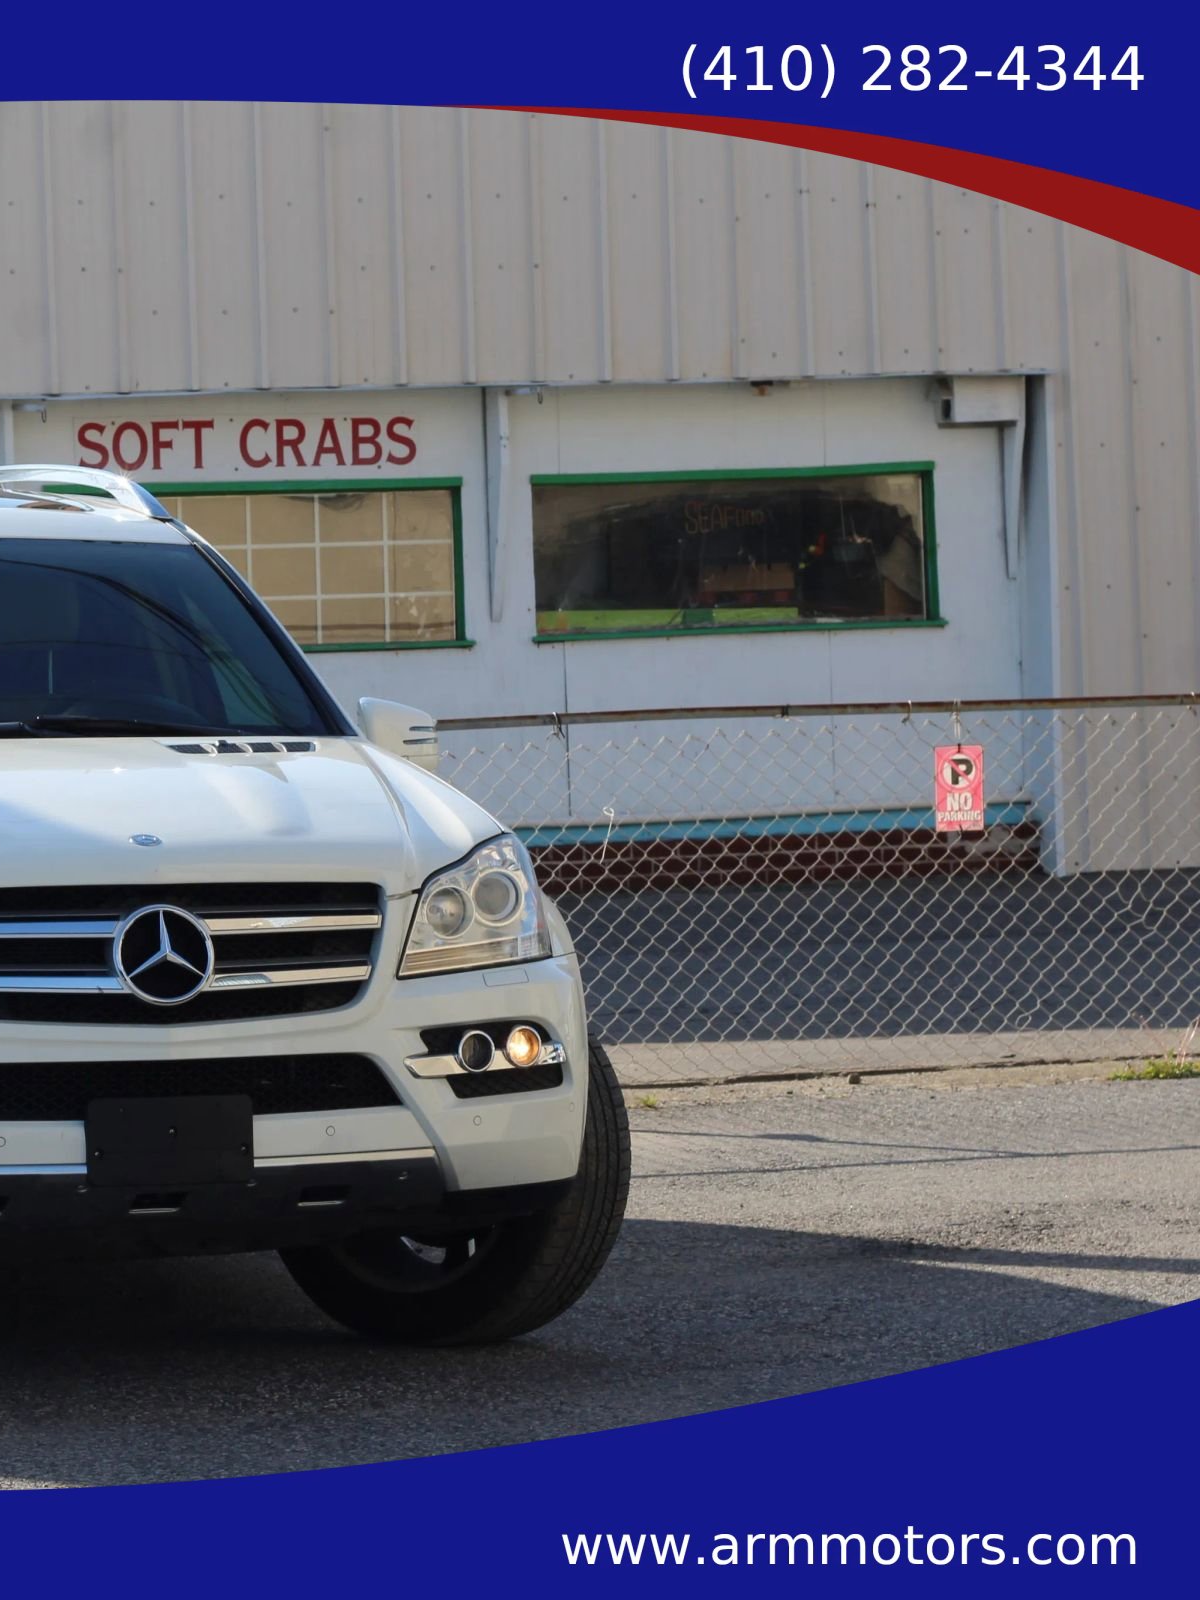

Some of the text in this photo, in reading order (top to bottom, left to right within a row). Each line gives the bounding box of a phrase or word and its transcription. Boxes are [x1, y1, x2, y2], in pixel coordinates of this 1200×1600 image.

[77, 416, 418, 471] SOFT CRABS
[946, 791, 973, 811] NO
[938, 809, 981, 822] PARKING
